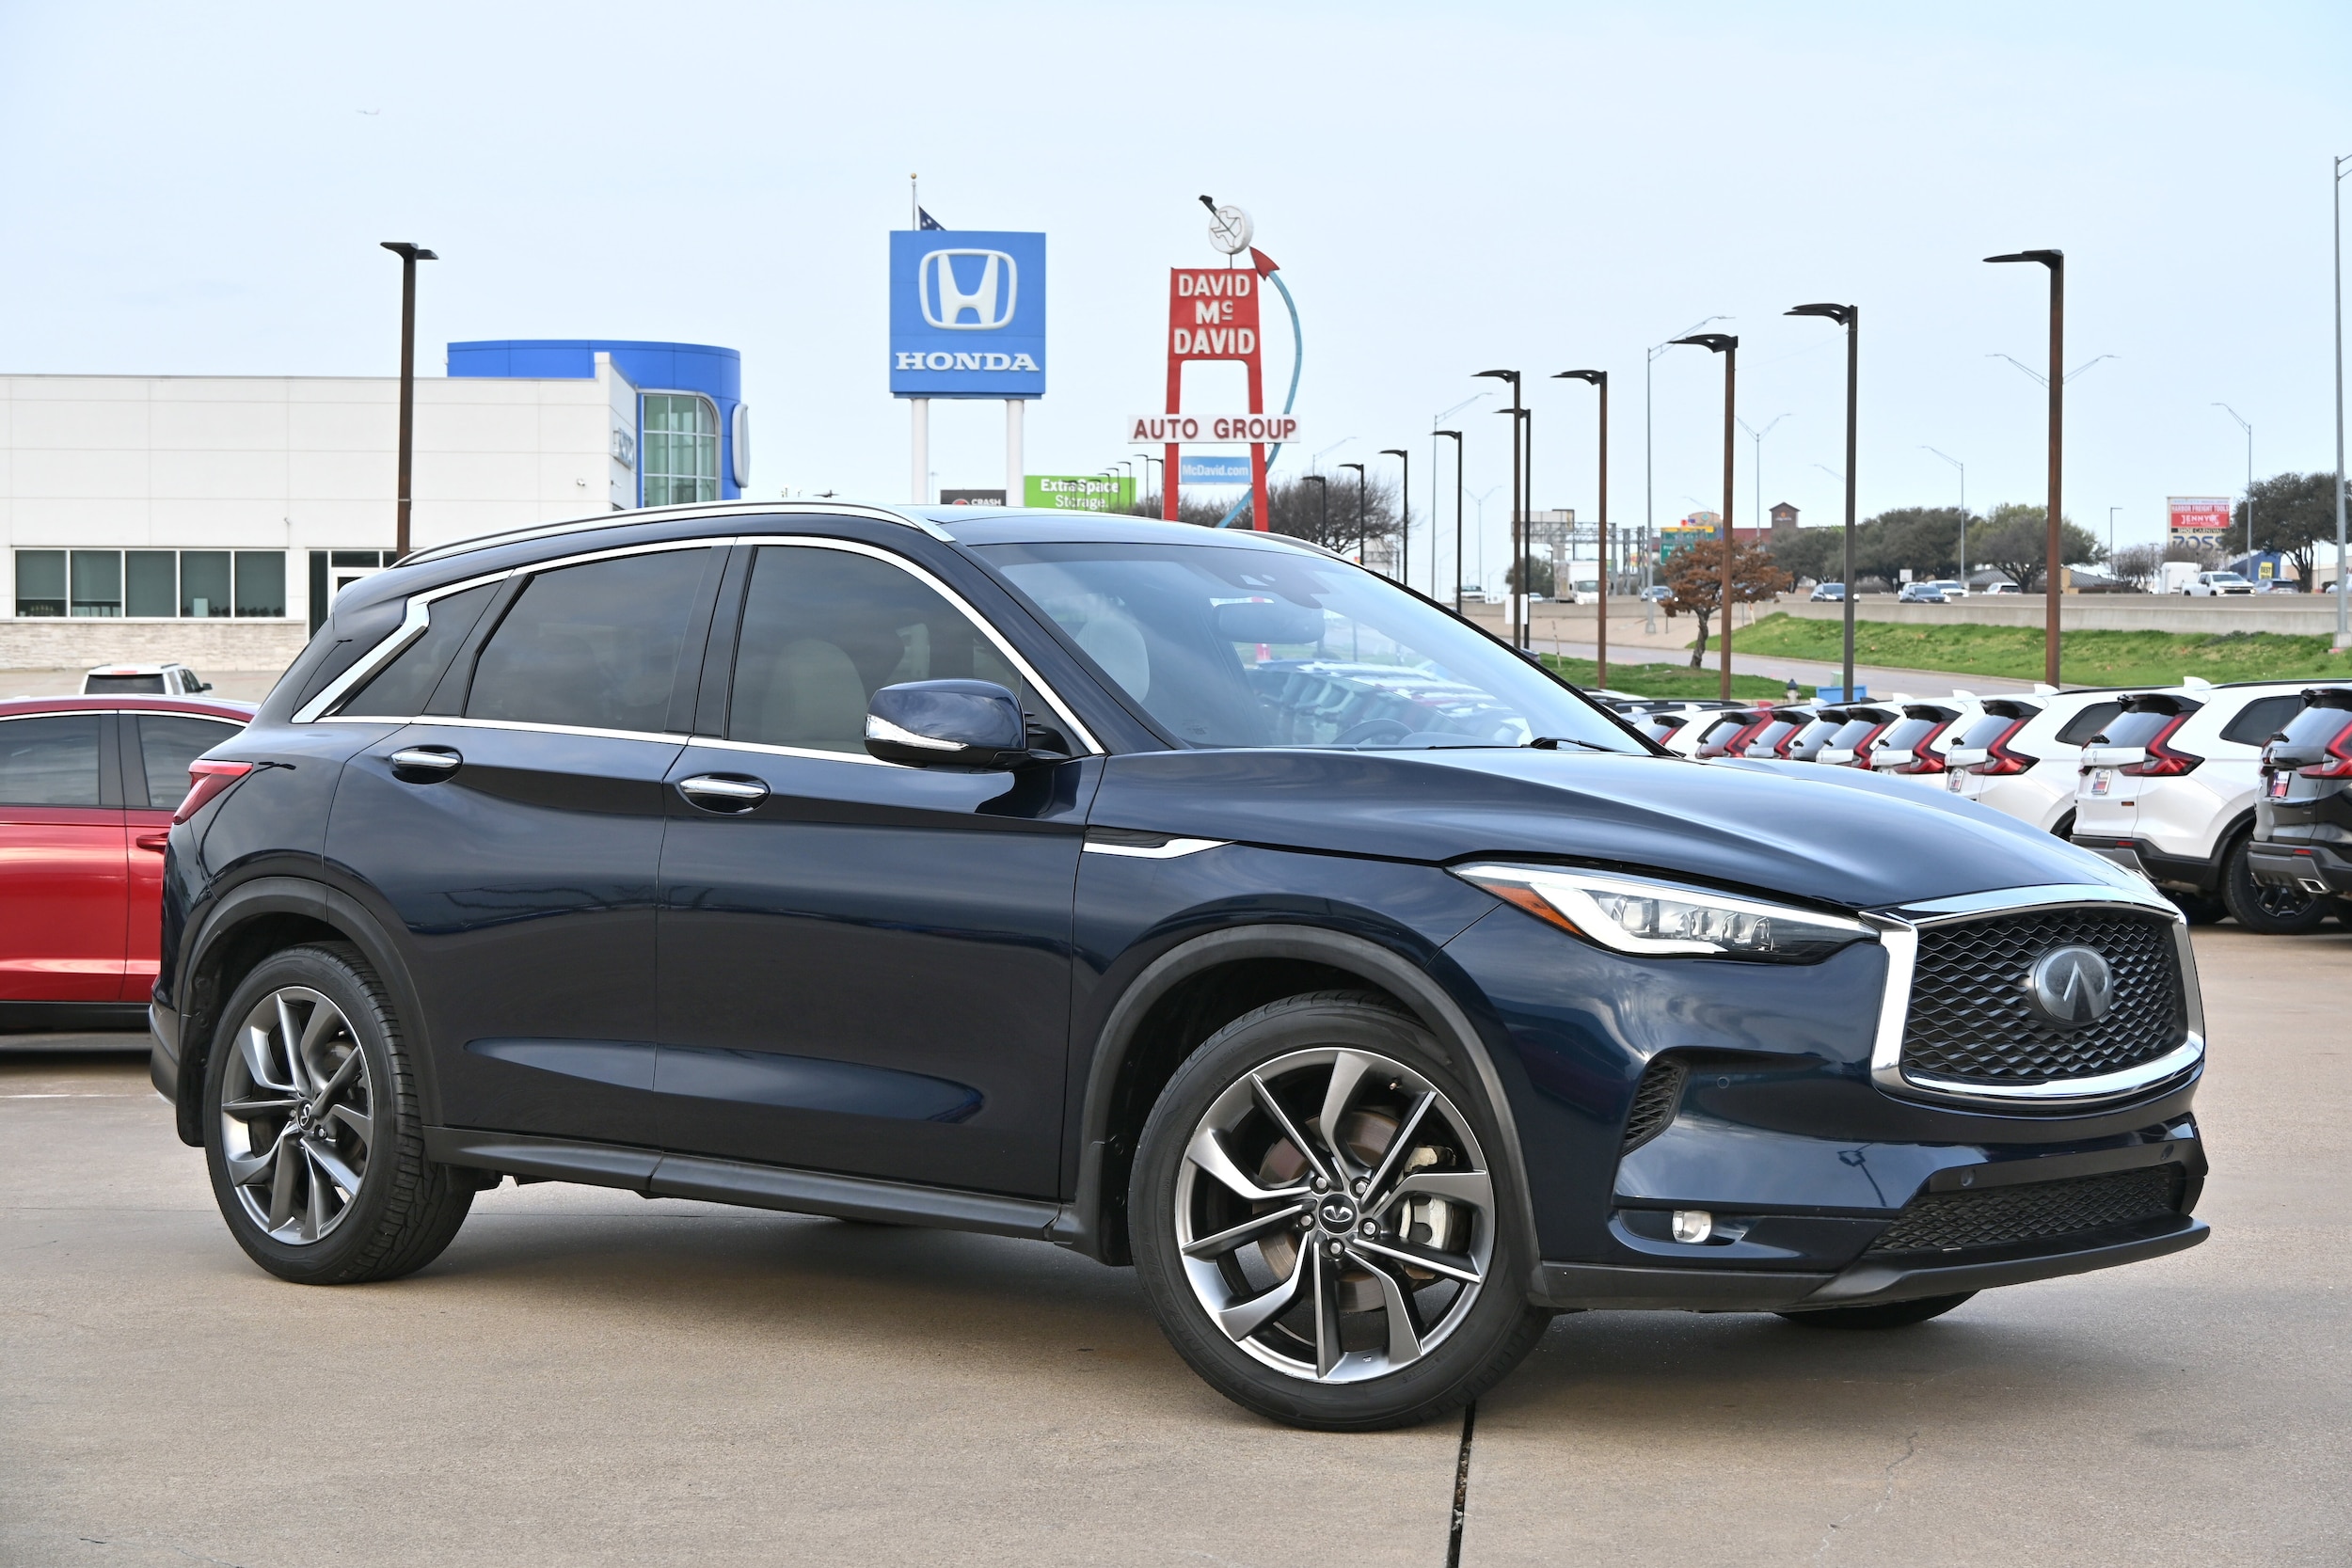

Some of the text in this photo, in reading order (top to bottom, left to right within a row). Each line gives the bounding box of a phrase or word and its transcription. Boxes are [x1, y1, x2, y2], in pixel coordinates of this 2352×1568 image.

[1178, 274, 1251, 297] DAVID
[1173, 327, 1256, 355] DAVID
[896, 352, 1041, 372] HONDA
[1133, 418, 1296, 439] AUTO GROUP
[1182, 464, 1249, 477] McDavid.com
